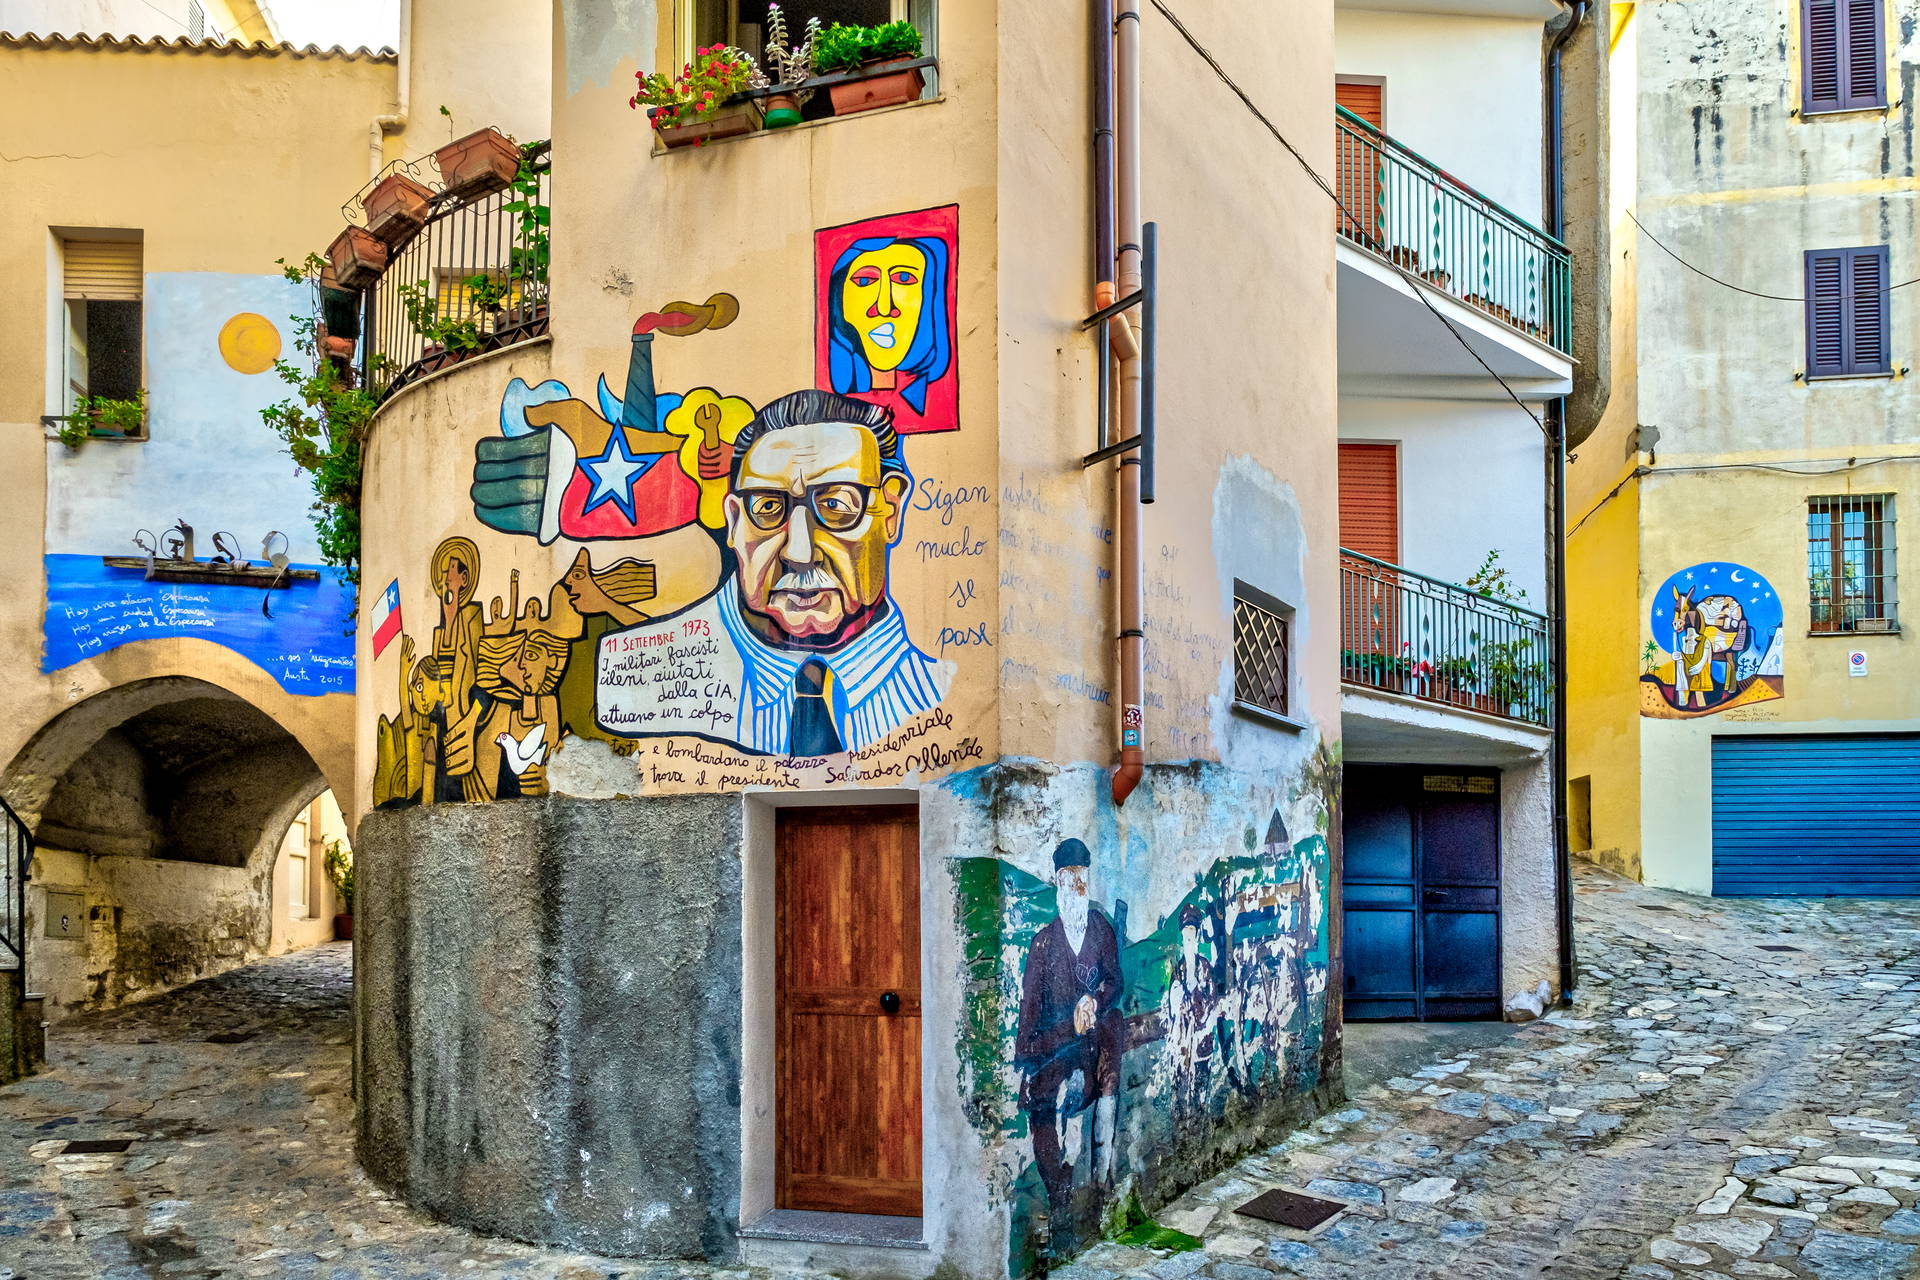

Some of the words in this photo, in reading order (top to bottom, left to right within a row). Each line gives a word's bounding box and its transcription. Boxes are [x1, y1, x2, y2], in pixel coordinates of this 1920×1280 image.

[913, 478, 991, 526] Sigan
[915, 526, 988, 563] mucho
[65, 605, 89, 620] Hay
[72, 622, 91, 636] Hay
[77, 636, 102, 654] Hay
[138, 617, 150, 628] de
[153, 616, 168, 627] la
[605, 638, 617, 653] 11
[681, 619, 711, 637] 1973
[935, 622, 993, 659] pase
[613, 649, 662, 672] militari
[667, 637, 719, 666] fascisti
[320, 675, 343, 685] 2015
[600, 669, 650, 687] cileni,
[652, 658, 714, 682] aiutati
[657, 680, 698, 703] dalla
[600, 703, 656, 724] attuano
[661, 707, 683, 719] un
[688, 700, 734, 731] colpo
[652, 745, 660, 755] e
[665, 740, 749, 767] bombardano
[755, 758, 769, 772] il
[849, 707, 953, 764] presidenziale
[650, 763, 686, 788] trova
[695, 770, 709, 786] il
[717, 771, 800, 790] presidente
[824, 761, 903, 784] Salvador
[905, 737, 984, 774] Allende
